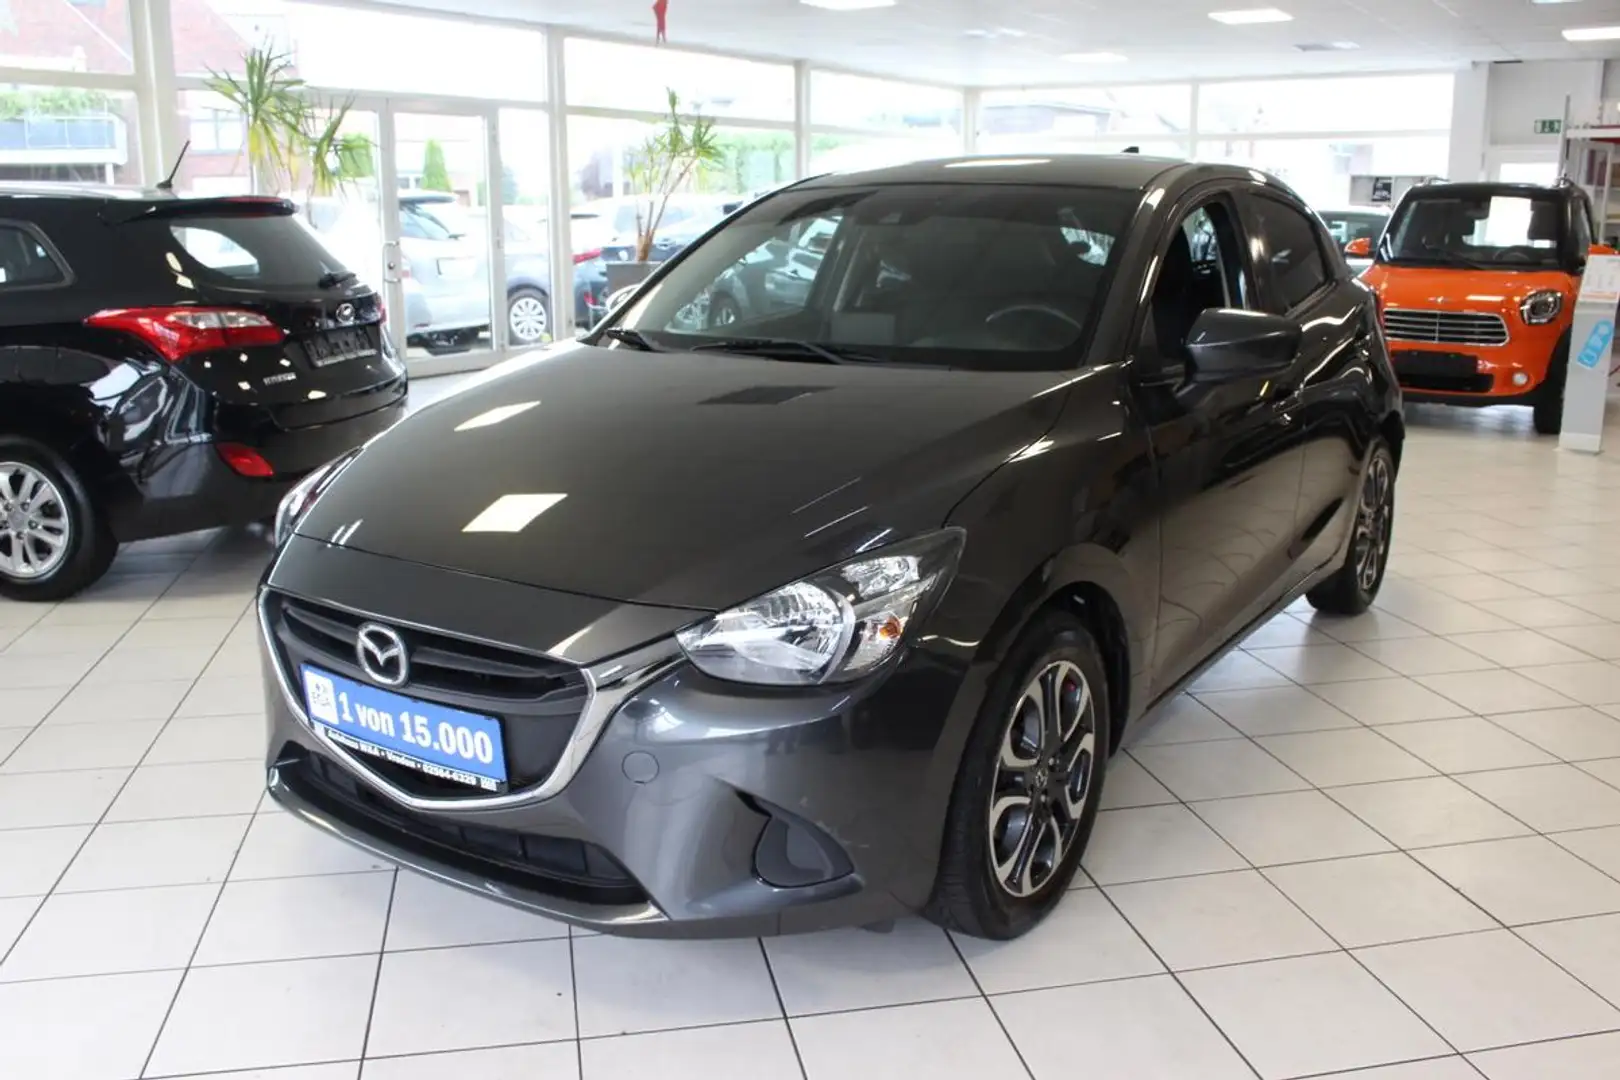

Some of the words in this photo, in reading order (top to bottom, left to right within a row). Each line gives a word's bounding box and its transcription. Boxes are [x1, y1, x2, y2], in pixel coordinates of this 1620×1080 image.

[338, 691, 354, 723] 1
[355, 703, 396, 738] von
[399, 711, 494, 765] 15.000
